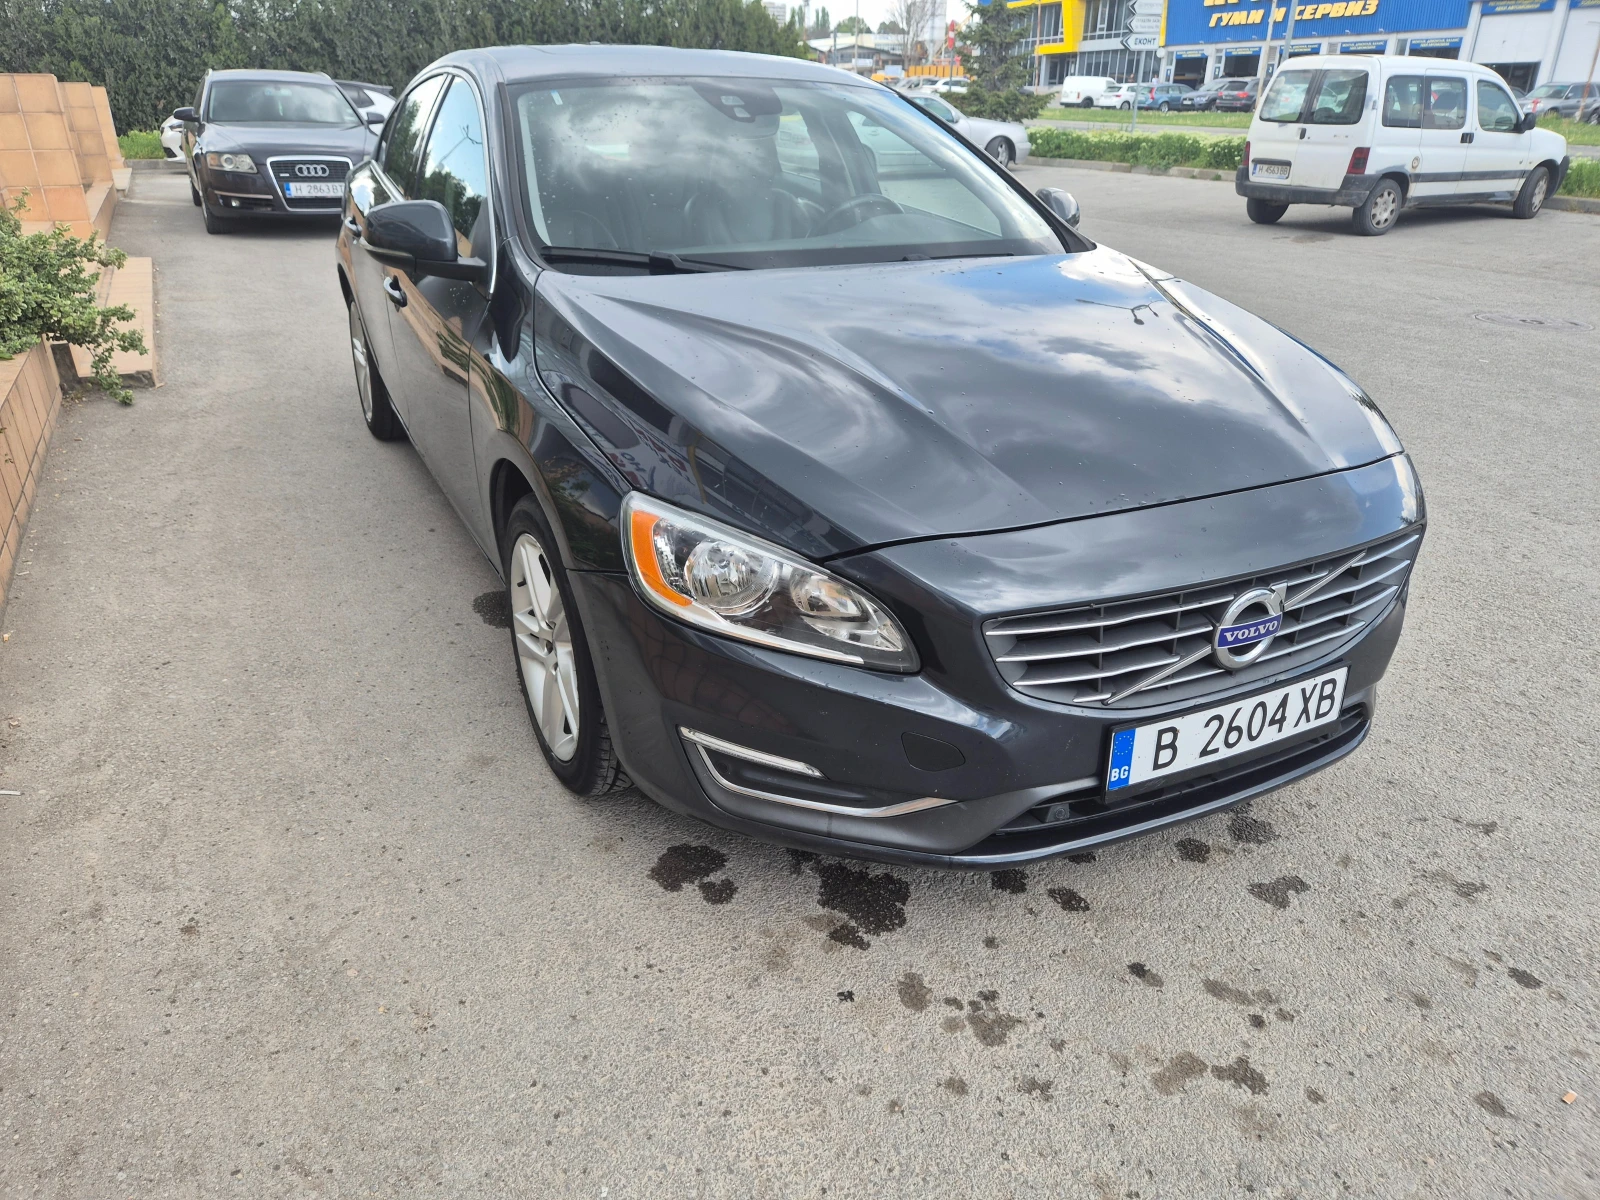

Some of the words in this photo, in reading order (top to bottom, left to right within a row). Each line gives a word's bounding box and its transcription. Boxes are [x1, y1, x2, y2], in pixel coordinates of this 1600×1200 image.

[1209, 9, 1264, 27] ГУМИ
[1268, 7, 1287, 22] И
[1294, 0, 1379, 21] СЕРВИЗ
[1134, 37, 1156, 46] ЕКОНТ
[1265, 165, 1280, 175] 4563
[295, 185, 303, 195] H
[307, 184, 331, 195] 2863
[1223, 619, 1278, 643] VOLVO
[1152, 725, 1179, 771] B
[1199, 692, 1290, 759] 2604
[1293, 677, 1338, 728] XB
[1110, 766, 1129, 782] BG
